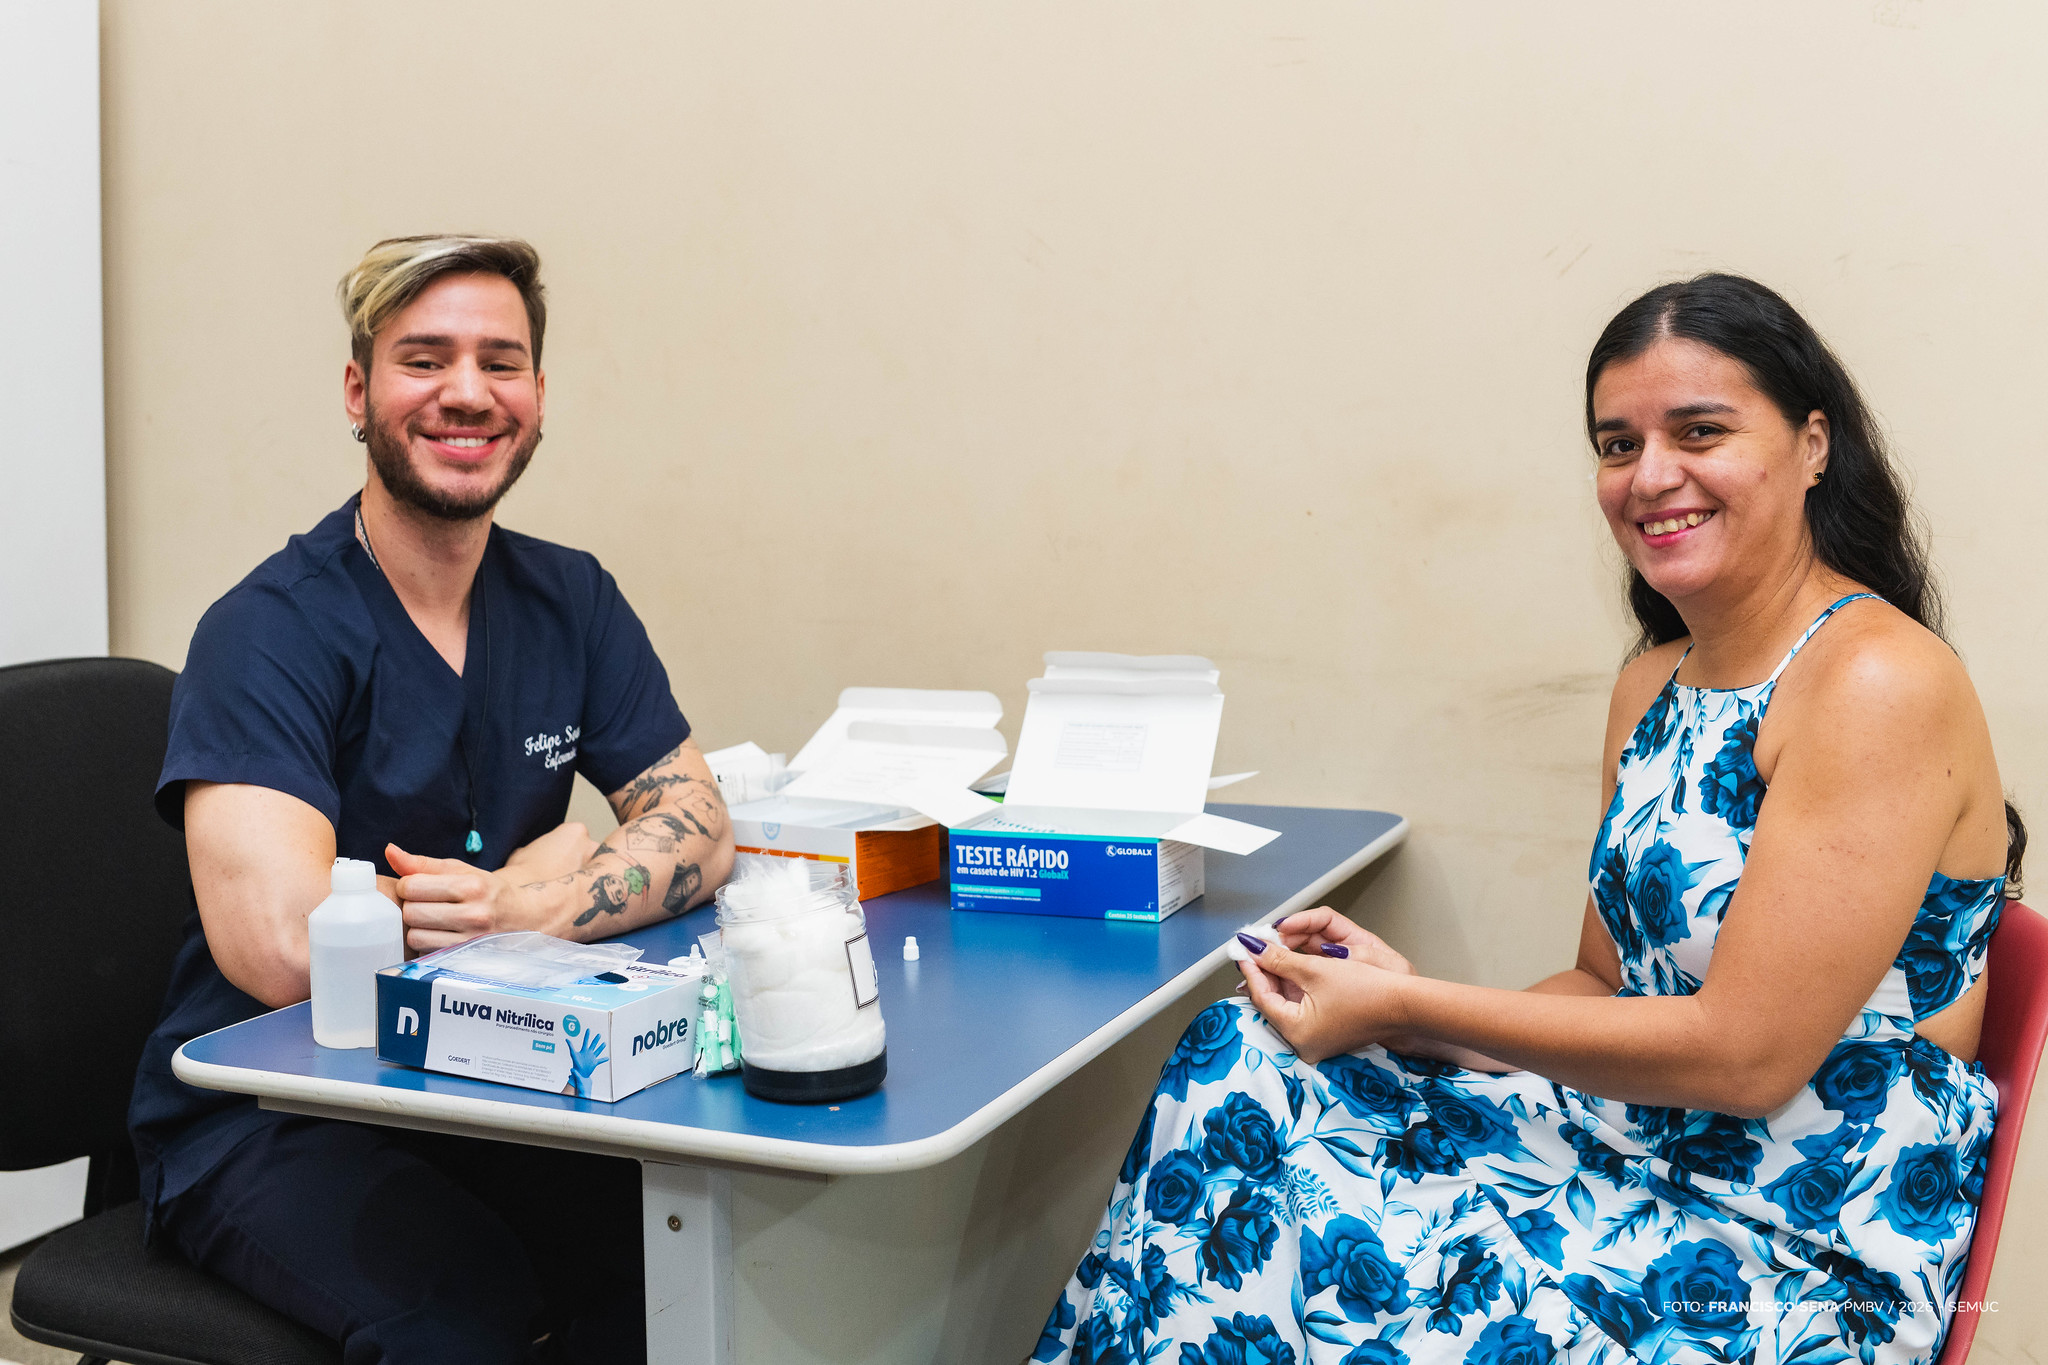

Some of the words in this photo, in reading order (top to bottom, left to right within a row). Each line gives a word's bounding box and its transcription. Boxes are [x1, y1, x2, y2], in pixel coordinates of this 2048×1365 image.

[525, 733, 562, 756] Felipe
[956, 845, 1002, 867] TESTE
[1006, 845, 1069, 869] RÁPIDO
[1117, 847, 1152, 856] GLOBALX
[957, 866, 969, 875] em
[970, 867, 998, 876] cassete
[999, 867, 1009, 877] de
[1010, 868, 1024, 878] HIV
[1026, 869, 1038, 878] 1.2
[1038, 869, 1069, 880] GlobalX
[440, 994, 492, 1020] Luva
[496, 1009, 554, 1031] Nitrílica
[568, 1022, 576, 1032] G
[632, 1017, 688, 1056] nobre
